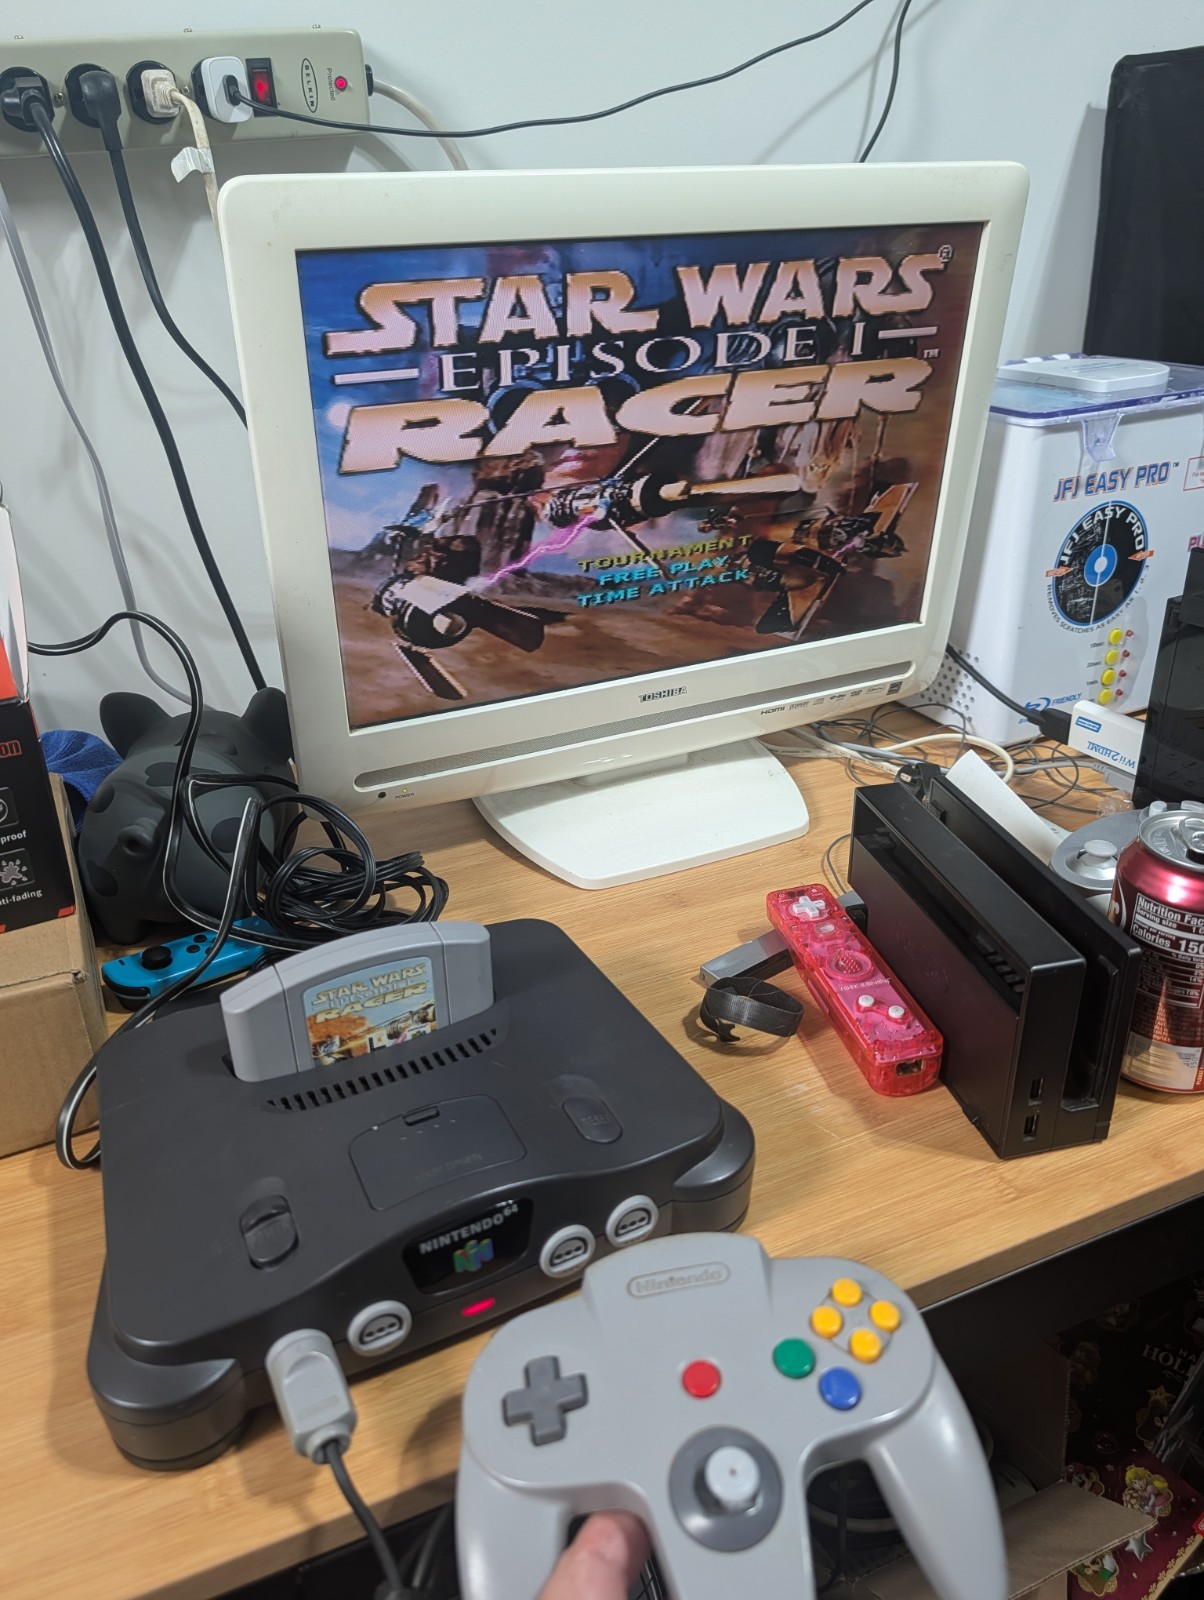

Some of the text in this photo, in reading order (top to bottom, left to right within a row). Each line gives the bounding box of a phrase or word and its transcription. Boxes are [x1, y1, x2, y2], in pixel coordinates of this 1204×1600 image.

[305, 64, 315, 107] BELKIN
[326, 67, 336, 102] Protected
[326, 254, 944, 355] STAR WARS
[440, 322, 866, 391] EPISODE I
[339, 357, 933, 474] RACER
[1053, 475, 1081, 502] JFJ
[1084, 468, 1133, 496] EASY
[1134, 461, 1171, 489] PRO
[578, 535, 752, 571] TOURNAMENT
[1059, 506, 1146, 565] JFJ EASY PRO
[577, 568, 749, 607] TIME ATTACK
[598, 554, 729, 586] FREE PLAY
[1060, 621, 1094, 634] SCRATCHES
[638, 685, 688, 702] TOSHIBA
[1051, 692, 1082, 706] FRIENDLY
[0, 829, 27, 845] proof
[1136, 905, 1161, 924] Serving
[1162, 918, 1178, 929] size
[1138, 896, 1181, 921] Nutrition
[1132, 923, 1171, 948] Calories
[311, 962, 426, 1007] STAR WARS
[314, 982, 428, 1024] RACER
[636, 1268, 723, 1294] Nintendo
